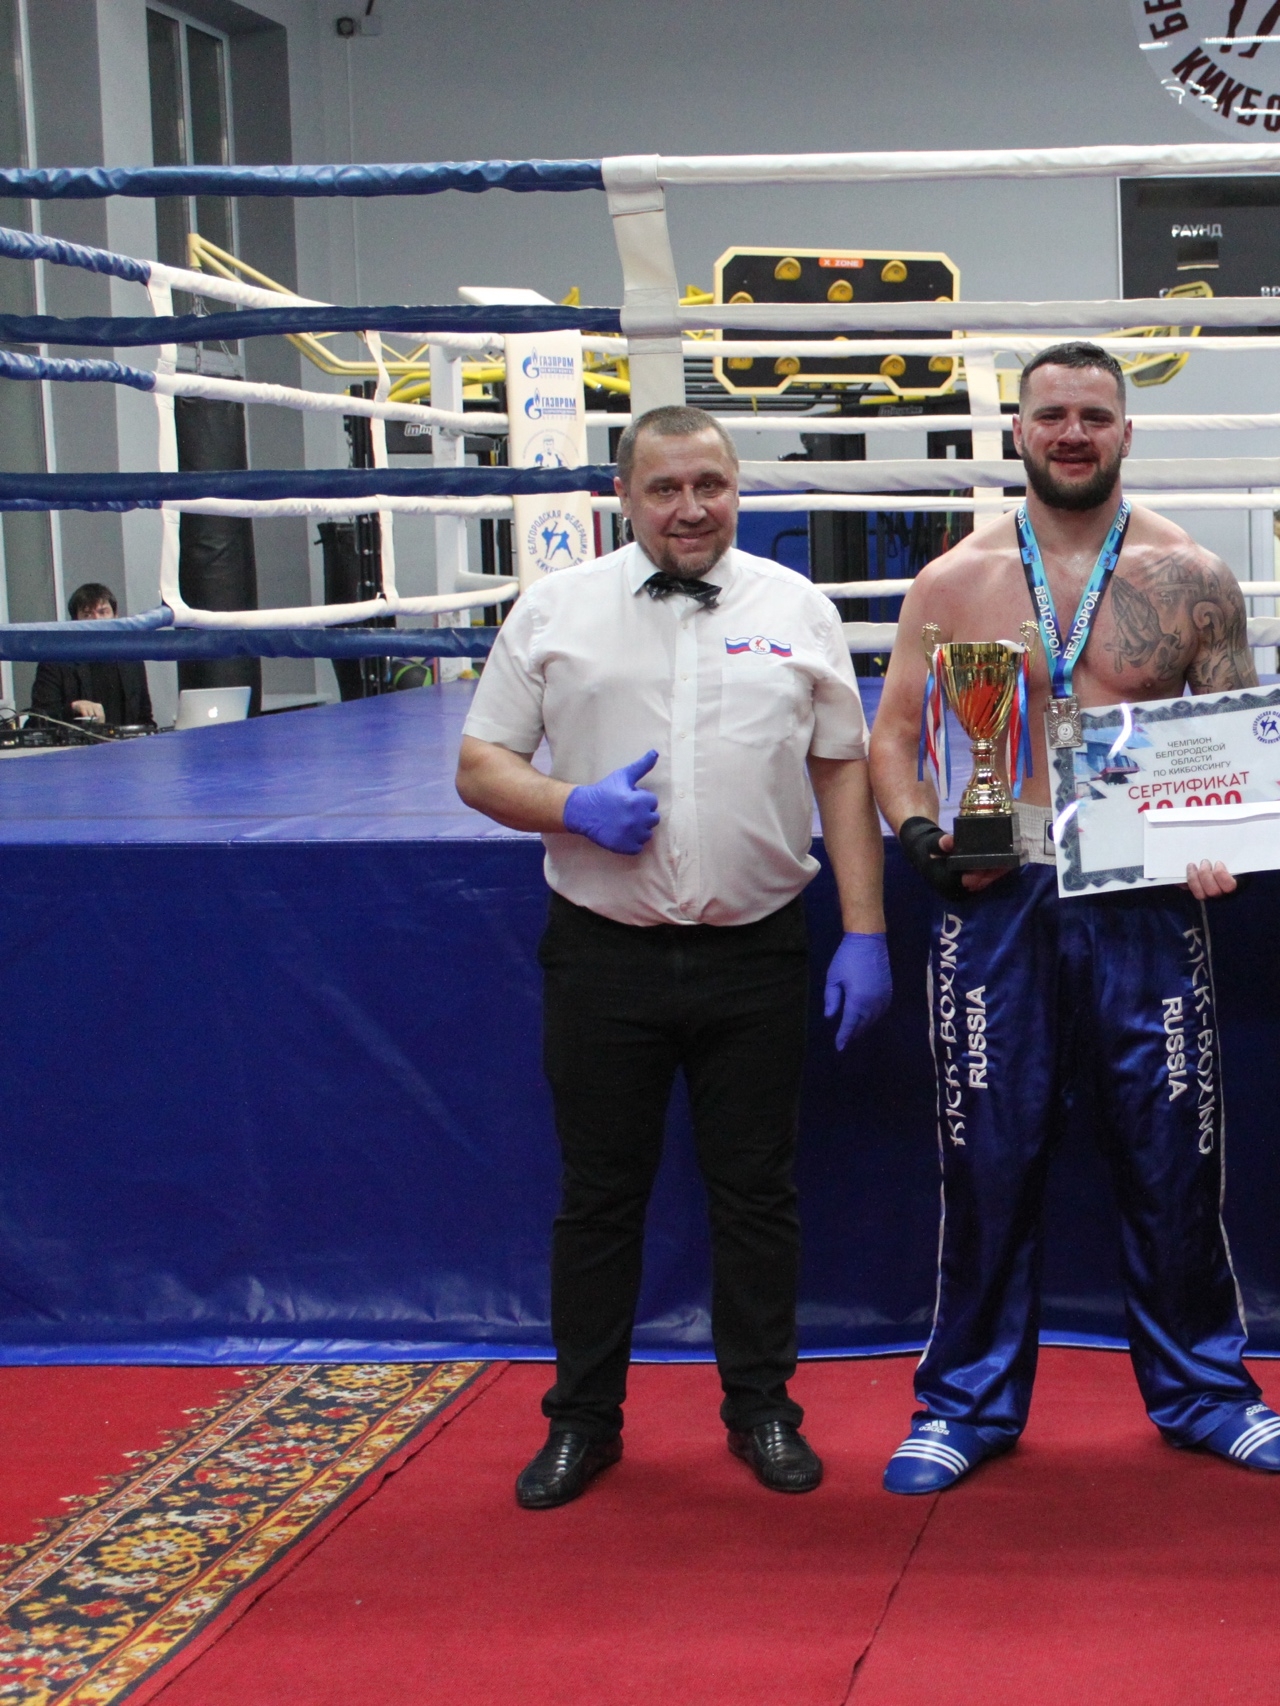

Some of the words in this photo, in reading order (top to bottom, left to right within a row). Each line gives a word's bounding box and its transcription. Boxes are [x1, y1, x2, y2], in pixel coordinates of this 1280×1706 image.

[1171, 223, 1223, 238] РАУНД
[835, 259, 859, 267] ZONE
[539, 356, 574, 367] ГАЗПРОМ
[541, 397, 577, 408] ГАЗПРОМ
[1034, 585, 1061, 659] БЕЛГОРОД
[1063, 590, 1101, 660] БЕЛГОРОД
[1062, 727, 1069, 736] 2
[1167, 736, 1212, 748] ЧЕМПИОН
[1155, 743, 1226, 759] БЕЛГОРОДСКОЙ
[1170, 754, 1213, 766] ОБЛАСТИ
[1153, 769, 1166, 778] ПО
[1168, 760, 1232, 776] КИКБОКСИНГУ
[1128, 771, 1250, 800] СЕРТИФИКАТ
[940, 910, 966, 1147] KICK-BOXING
[966, 985, 988, 1089] RUSSIA
[1183, 925, 1215, 1155] KICK-BOXING
[1161, 996, 1188, 1102] RUSSIA
[918, 1425, 950, 1436] adidas
